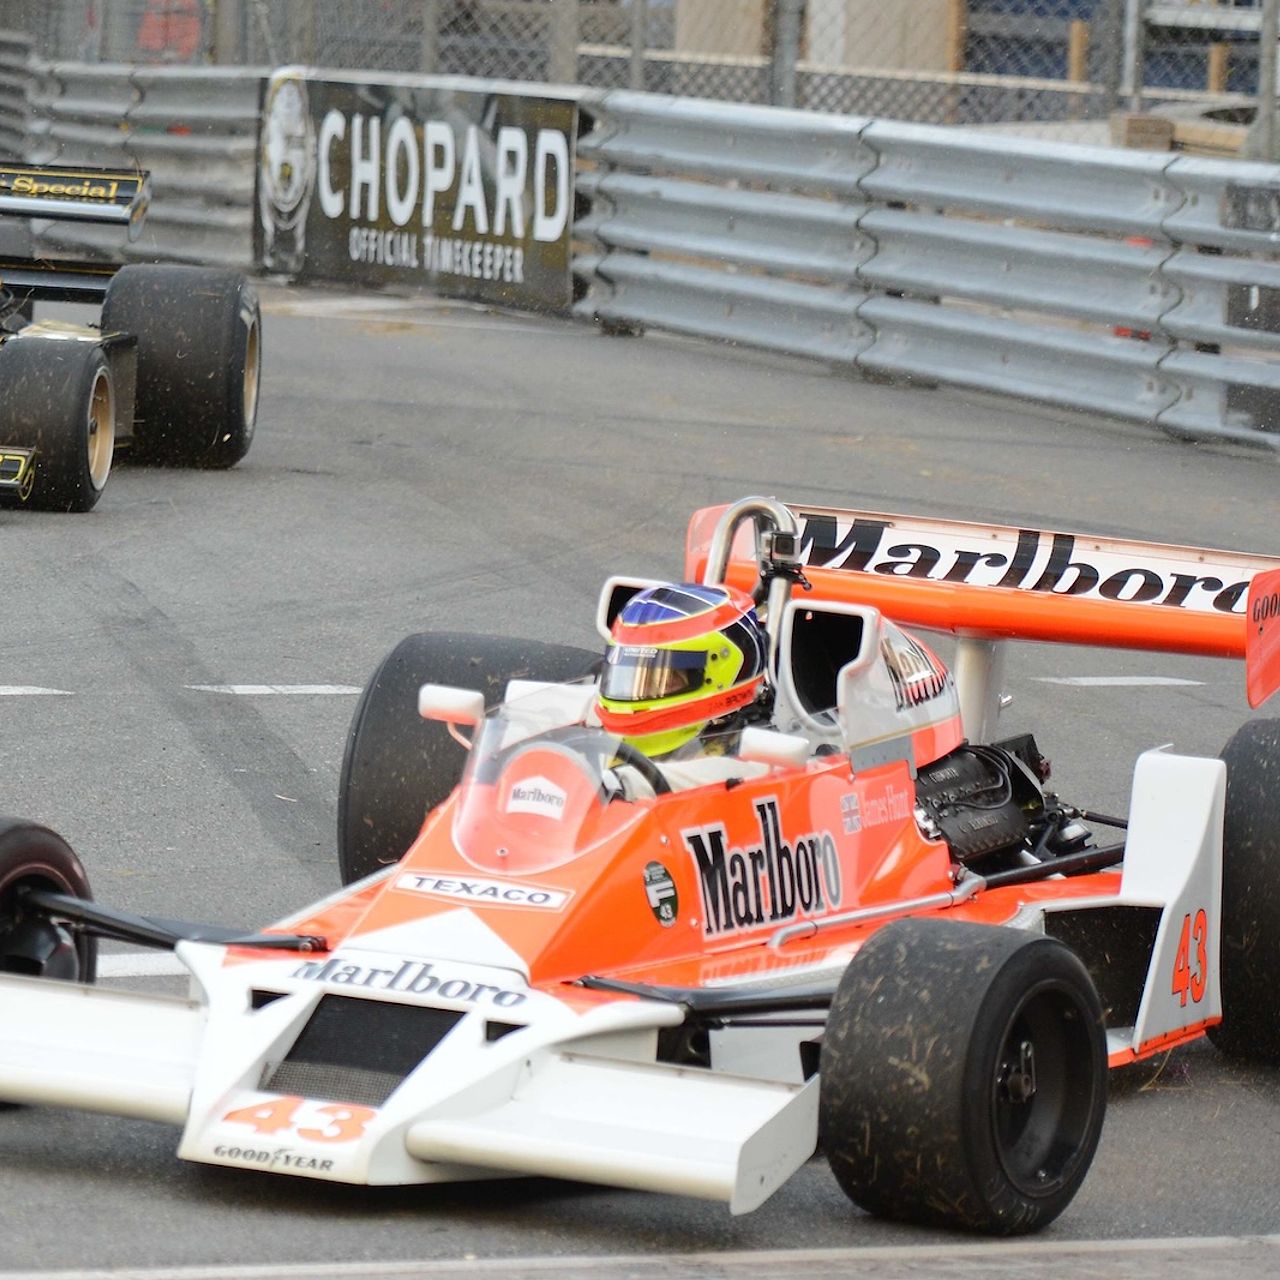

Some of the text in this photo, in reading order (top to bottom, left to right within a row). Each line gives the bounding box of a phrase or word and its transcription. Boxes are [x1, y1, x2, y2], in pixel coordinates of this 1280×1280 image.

[12, 177, 118, 198] Special
[318, 109, 569, 242] CHOPARD
[349, 227, 524, 283] OFFICIAL TIMEKEEPER
[799, 513, 1251, 614] Marlboro
[512, 785, 564, 808] Marlboro
[413, 876, 552, 906] TEXACO
[687, 795, 842, 935] Marlboro
[292, 959, 529, 1008] Marlboro
[1171, 909, 1208, 1007] 43
[221, 1096, 376, 1143] 43
